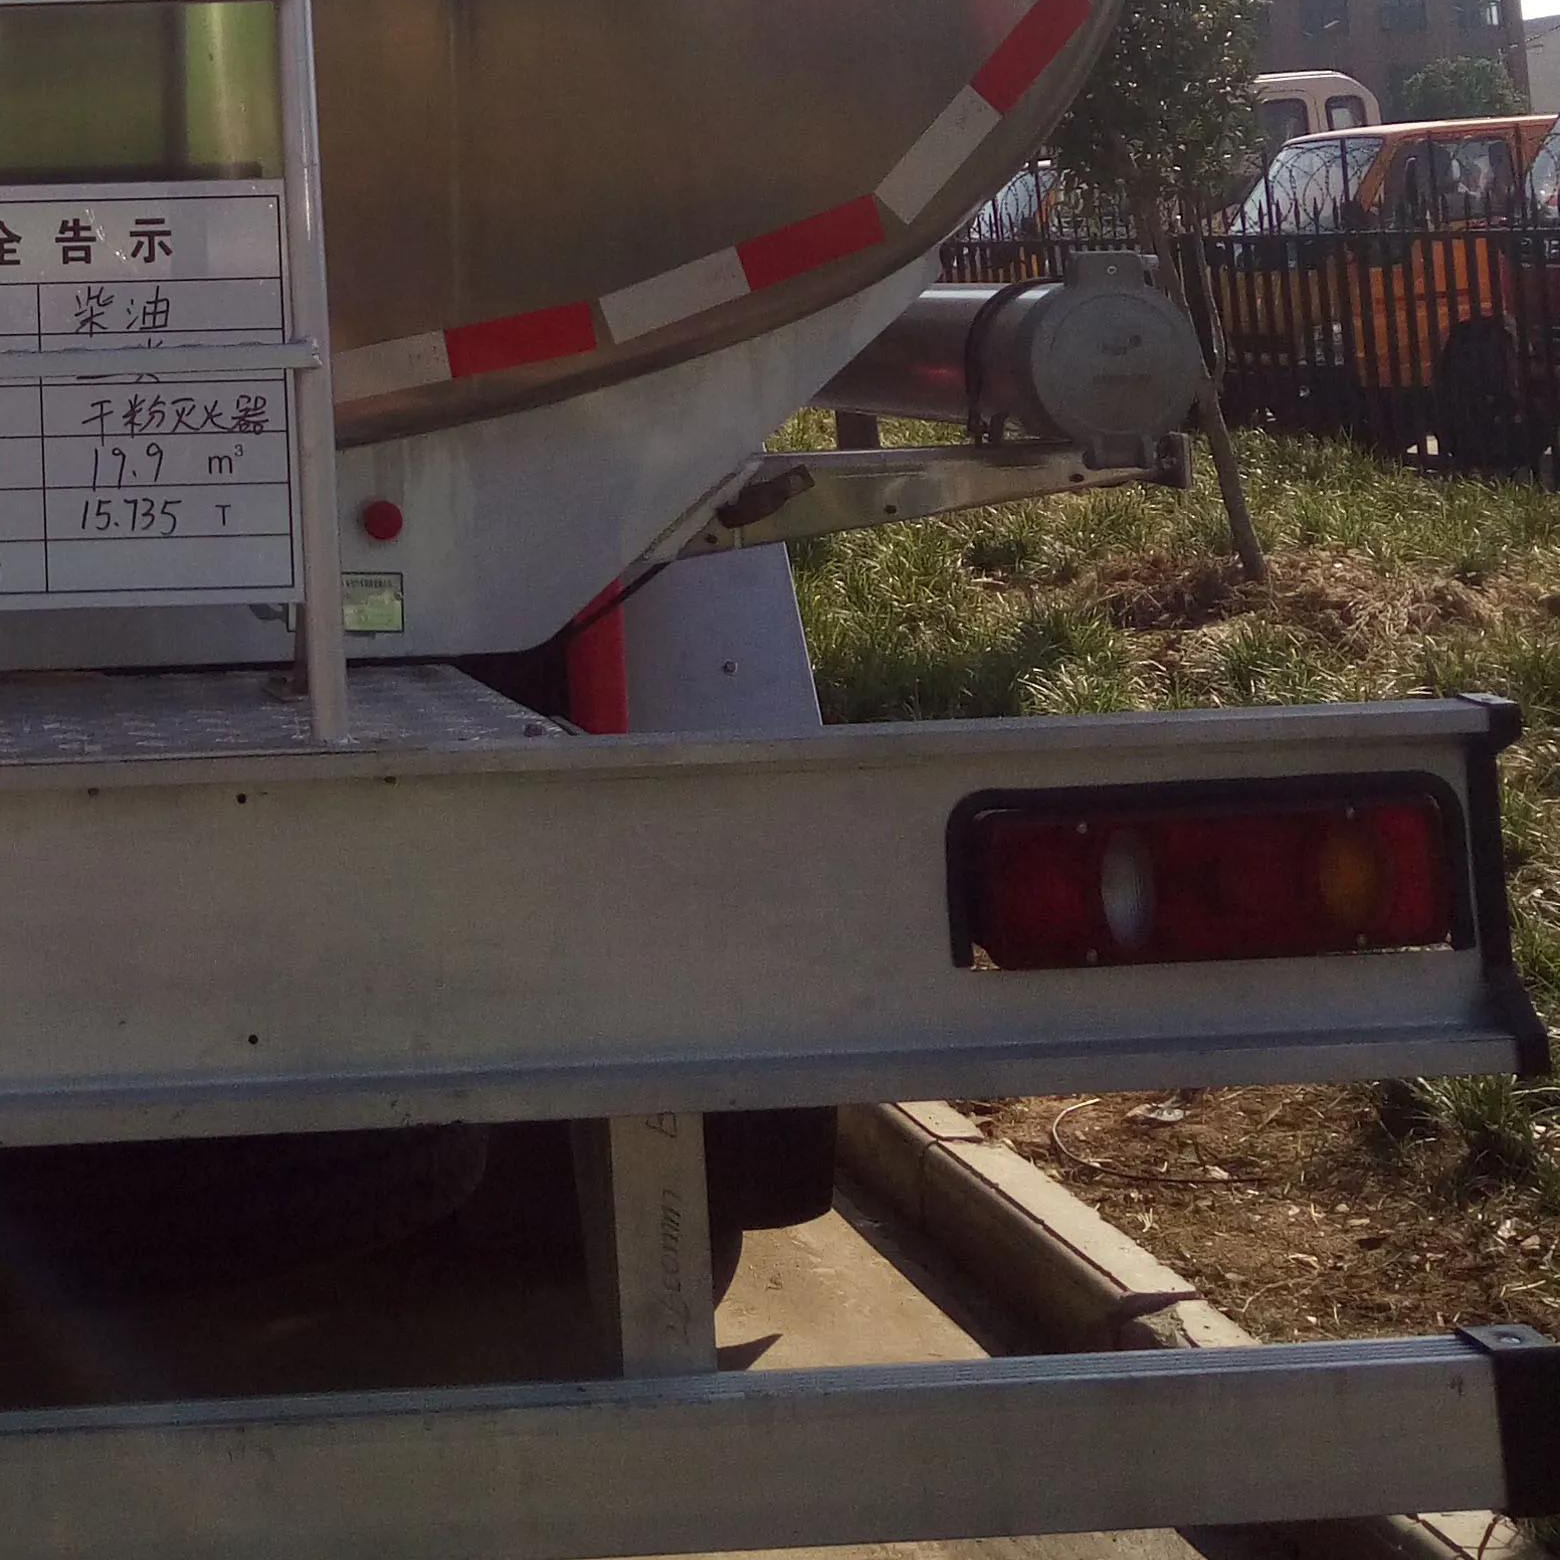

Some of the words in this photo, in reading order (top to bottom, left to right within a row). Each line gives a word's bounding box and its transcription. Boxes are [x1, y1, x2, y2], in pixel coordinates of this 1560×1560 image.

[74, 286, 170, 338] 柴油
[81, 393, 270, 443] 干粉灭火器
[92, 442, 164, 492] 19.9
[81, 497, 182, 535] 15.735
[214, 503, 232, 527] T
